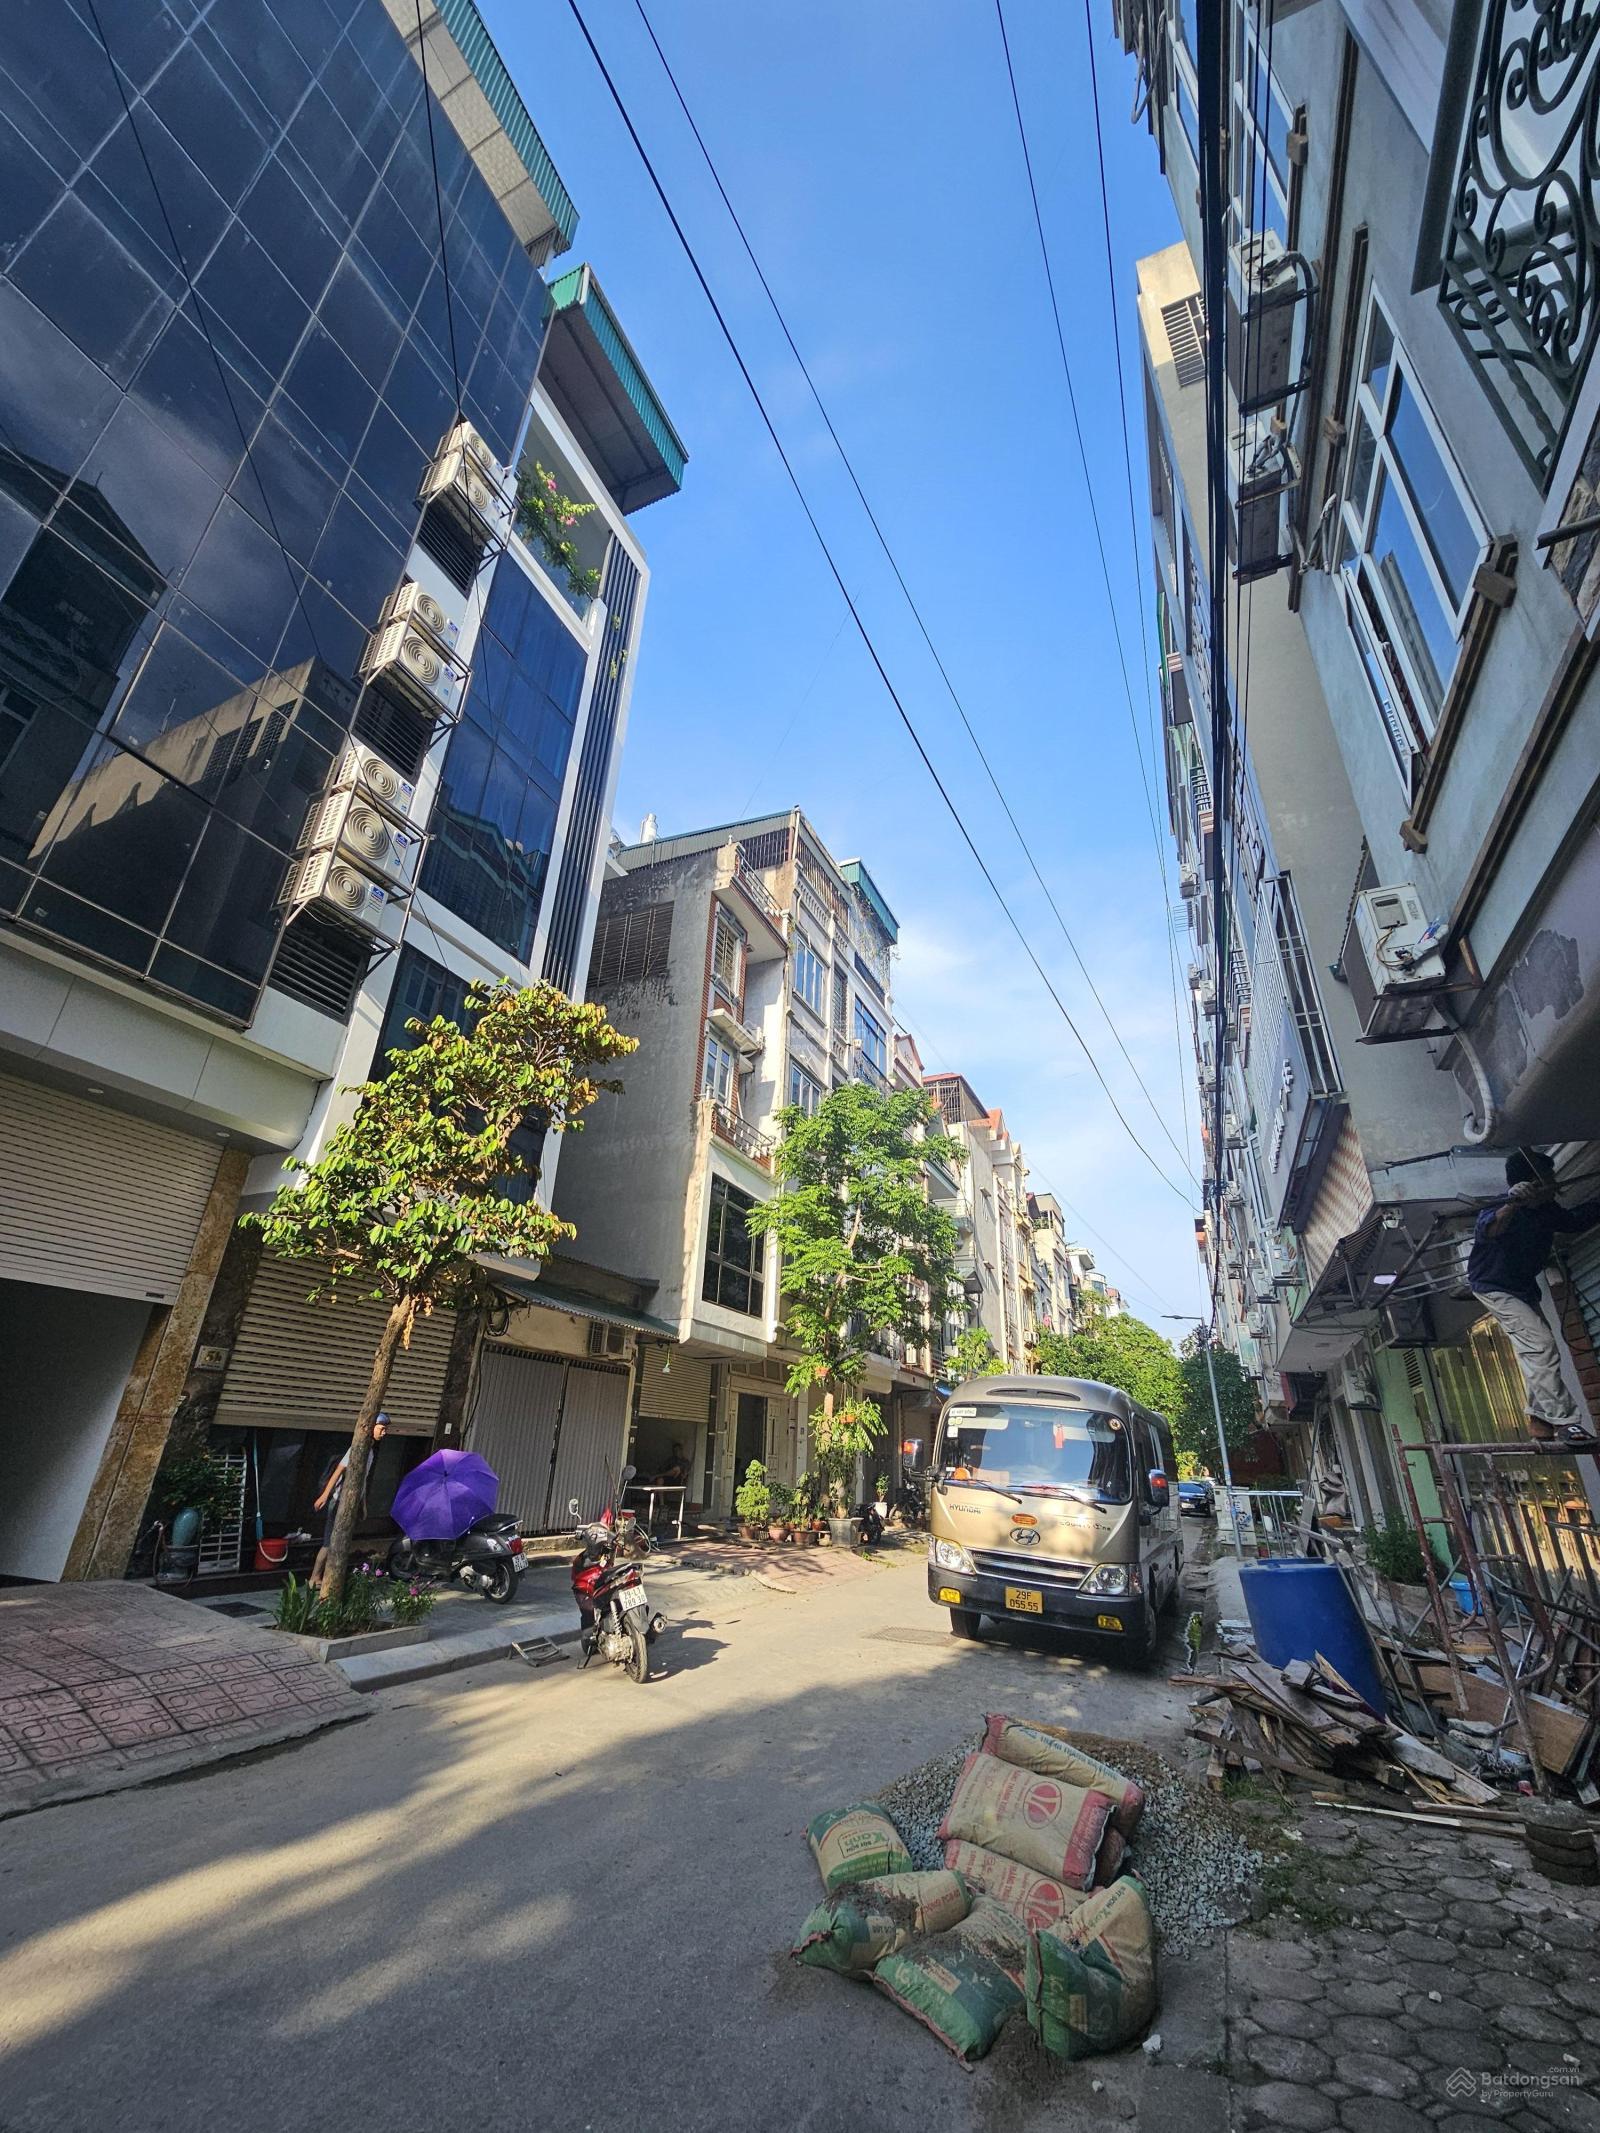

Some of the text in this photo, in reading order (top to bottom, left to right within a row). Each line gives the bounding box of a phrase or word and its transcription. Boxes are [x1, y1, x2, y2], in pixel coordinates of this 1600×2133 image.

[949, 1503, 982, 1514] HYUNDAI
[1015, 1590, 1032, 1600] 29F
[1009, 1599, 1039, 1611] 055.55
